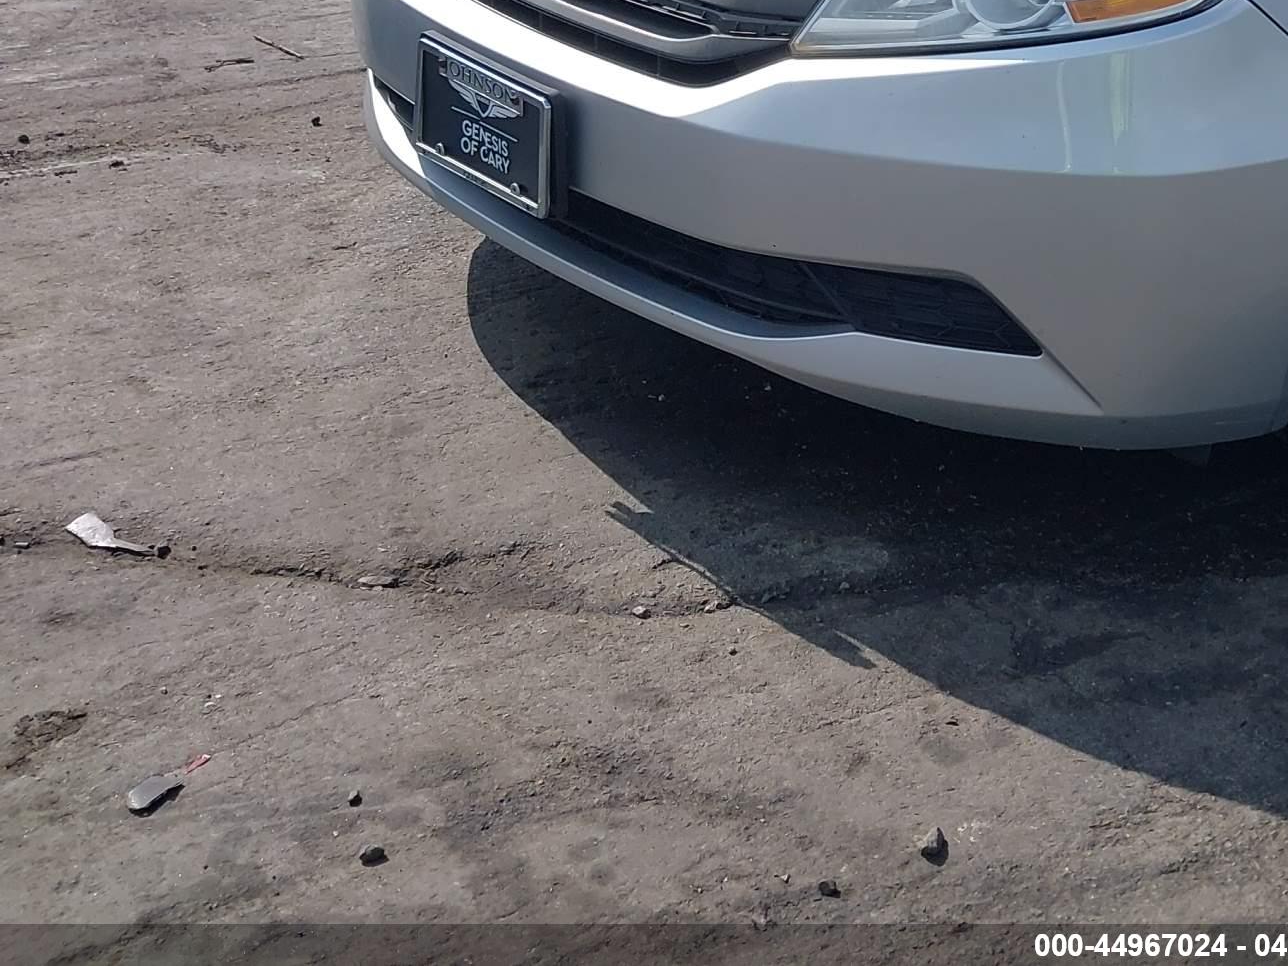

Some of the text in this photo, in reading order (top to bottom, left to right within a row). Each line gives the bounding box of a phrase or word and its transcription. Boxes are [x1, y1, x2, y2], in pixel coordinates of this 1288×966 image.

[460, 136, 479, 157] OF
[480, 145, 510, 175] CARY
[461, 119, 509, 158] GENESIS
